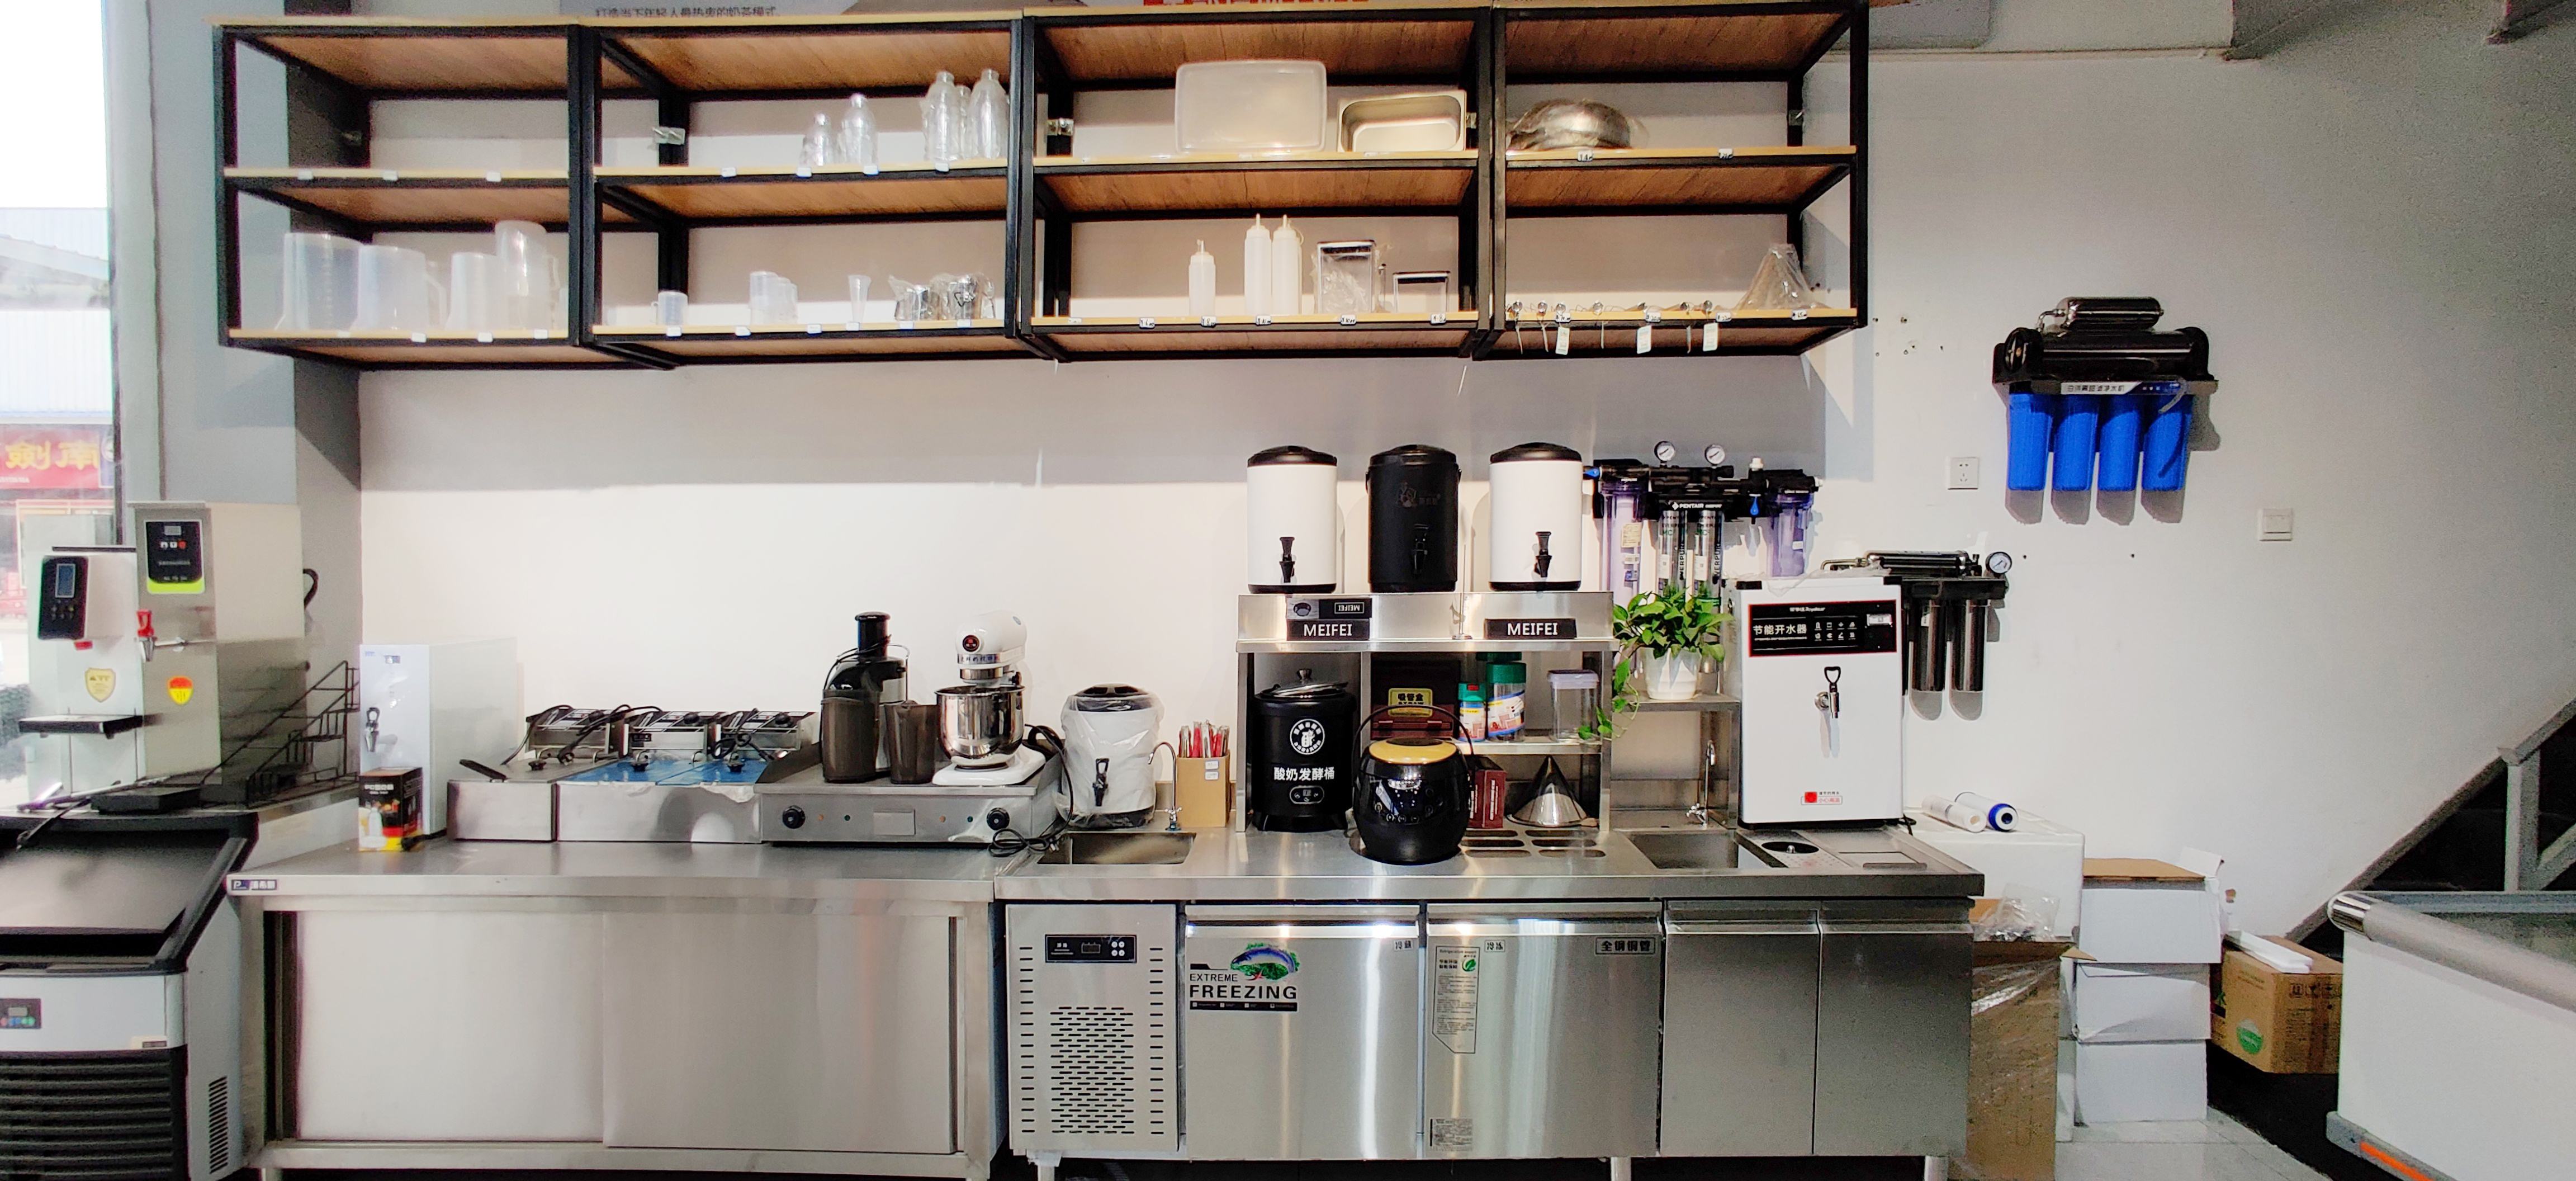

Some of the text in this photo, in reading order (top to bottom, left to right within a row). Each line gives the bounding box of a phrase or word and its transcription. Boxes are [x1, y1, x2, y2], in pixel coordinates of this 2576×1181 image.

[1304, 624, 1352, 636] MEIFEI
[1507, 622, 1558, 635] MEIFEI
[1753, 624, 1807, 635] 节能开水器
[1273, 767, 1335, 781] 酸奶发酵桶
[1190, 974, 1238, 982] EXTREME
[1190, 985, 1297, 999] FREEZING
